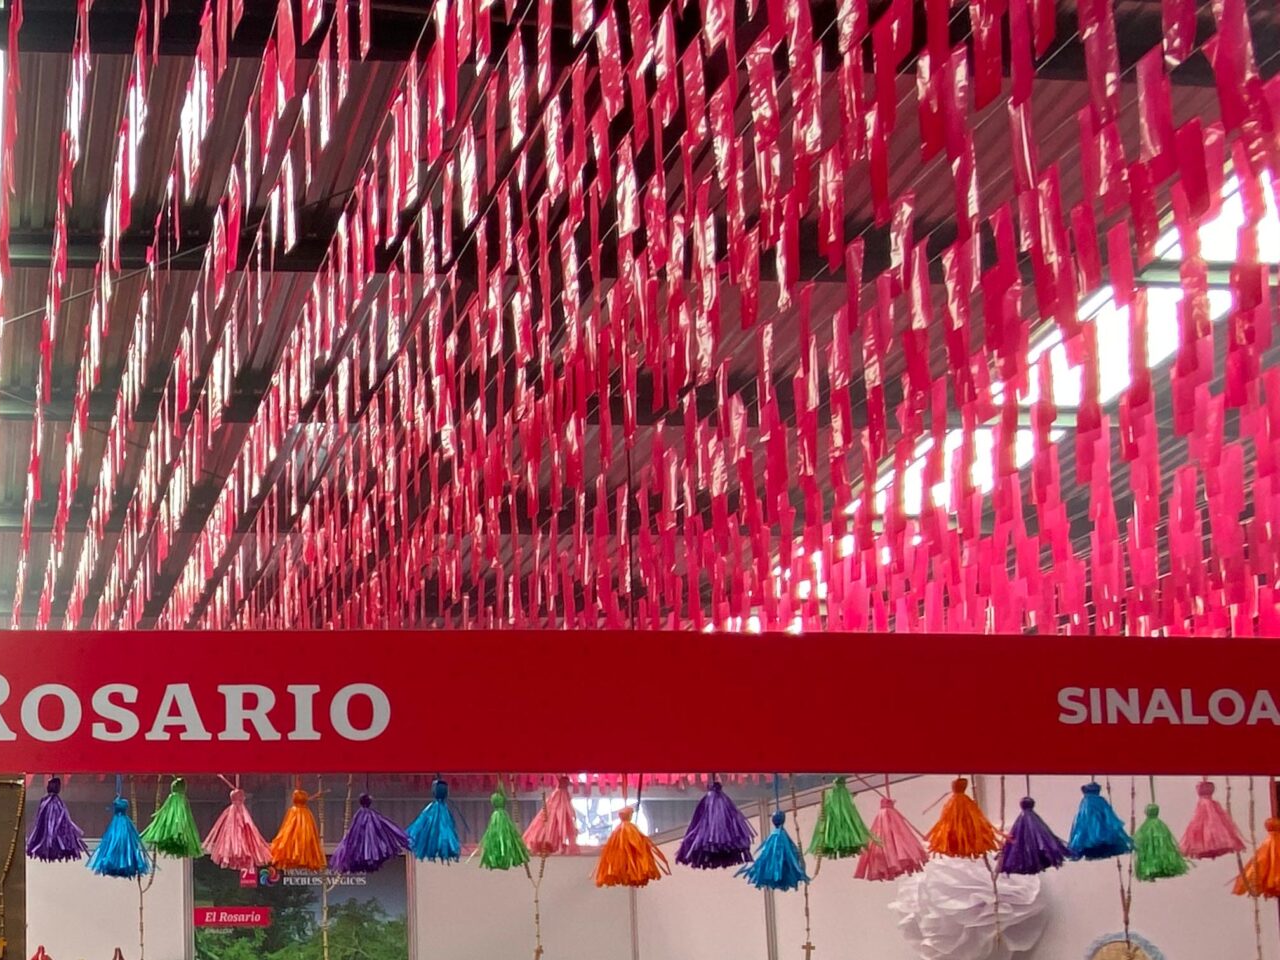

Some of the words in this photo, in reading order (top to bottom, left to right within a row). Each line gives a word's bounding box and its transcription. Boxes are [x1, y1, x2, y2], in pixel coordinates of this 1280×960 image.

[1057, 686, 1280, 726] SINALOA
[204, 911, 216, 923] El
[219, 911, 261, 923] Rosario
